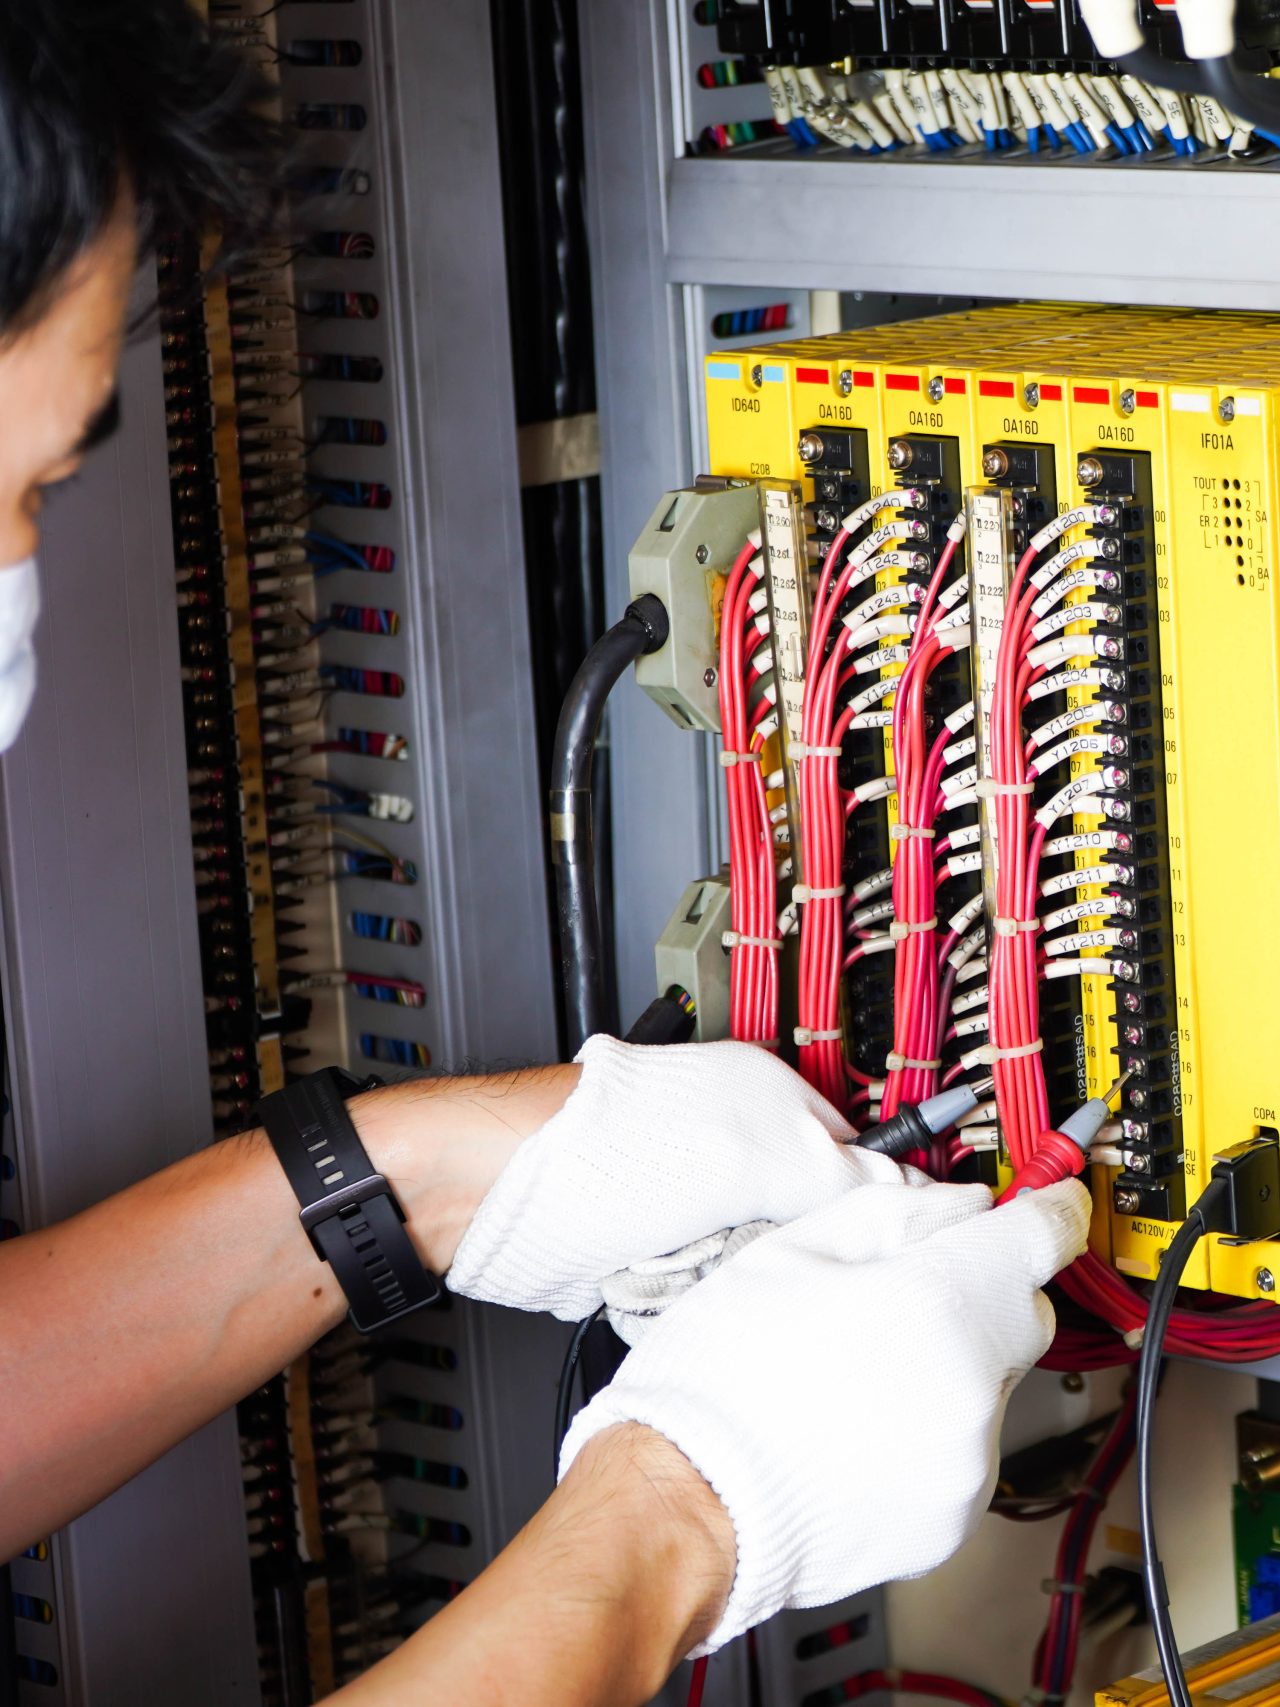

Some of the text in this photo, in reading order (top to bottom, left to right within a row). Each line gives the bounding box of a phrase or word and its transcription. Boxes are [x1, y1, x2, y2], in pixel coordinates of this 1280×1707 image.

[1166, 100, 1182, 119] 35
[1200, 98, 1220, 125] 24K
[731, 398, 760, 413] ID64D
[1194, 477, 1250, 493] TOUT 3
[856, 497, 901, 524] Y1240
[1212, 497, 1251, 512] 3 2
[1154, 510, 1166, 523] 00
[1200, 516, 1210, 527] ER
[1213, 517, 1219, 528] 2
[1255, 510, 1267, 523] SA
[1043, 511, 1086, 540] Y1200
[858, 525, 897, 555] Y1241
[1156, 543, 1167, 556] 01
[857, 553, 900, 577] Y1242
[1043, 545, 1085, 577] Y1201
[1257, 567, 1270, 580] BA
[1042, 570, 1085, 603] Y1202
[1158, 577, 1169, 589] 02
[858, 592, 901, 620] Y1243
[1045, 606, 1092, 630] Y1203
[1159, 610, 1171, 622] 03
[1041, 668, 1088, 690] Y1204
[1162, 674, 1173, 687] 04
[863, 680, 900, 704] Y124
[1067, 696, 1079, 709] 05
[1046, 705, 1094, 735] Y1205
[1163, 707, 1175, 720] 05
[1052, 738, 1099, 761] Y1206
[1165, 740, 1177, 753] 06
[1070, 761, 1081, 773] 07
[1166, 773, 1178, 785] 07
[1048, 779, 1090, 814] Y1207
[888, 799, 898, 811] 10
[1052, 833, 1101, 851] Y1210
[1170, 836, 1181, 849] 10
[1054, 868, 1102, 889] Y1211
[1171, 869, 1182, 881] 11
[1077, 888, 1088, 900] 12
[1055, 901, 1106, 924] Y1212
[1173, 901, 1184, 914] 12
[1079, 920, 1090, 932] 13
[1059, 933, 1106, 952] Y1213
[1175, 934, 1186, 947] 13
[1082, 982, 1093, 994] 14
[1177, 996, 1189, 1009] 14
[1084, 1014, 1095, 1027] 15
[1180, 1029, 1191, 1042] 15
[1086, 1046, 1097, 1058] 16
[1181, 1061, 1192, 1074] 16
[1088, 1077, 1098, 1090] 17
[1183, 1093, 1193, 1106] 17
[1185, 1148, 1196, 1162] FU
[1186, 1163, 1196, 1176] SE
